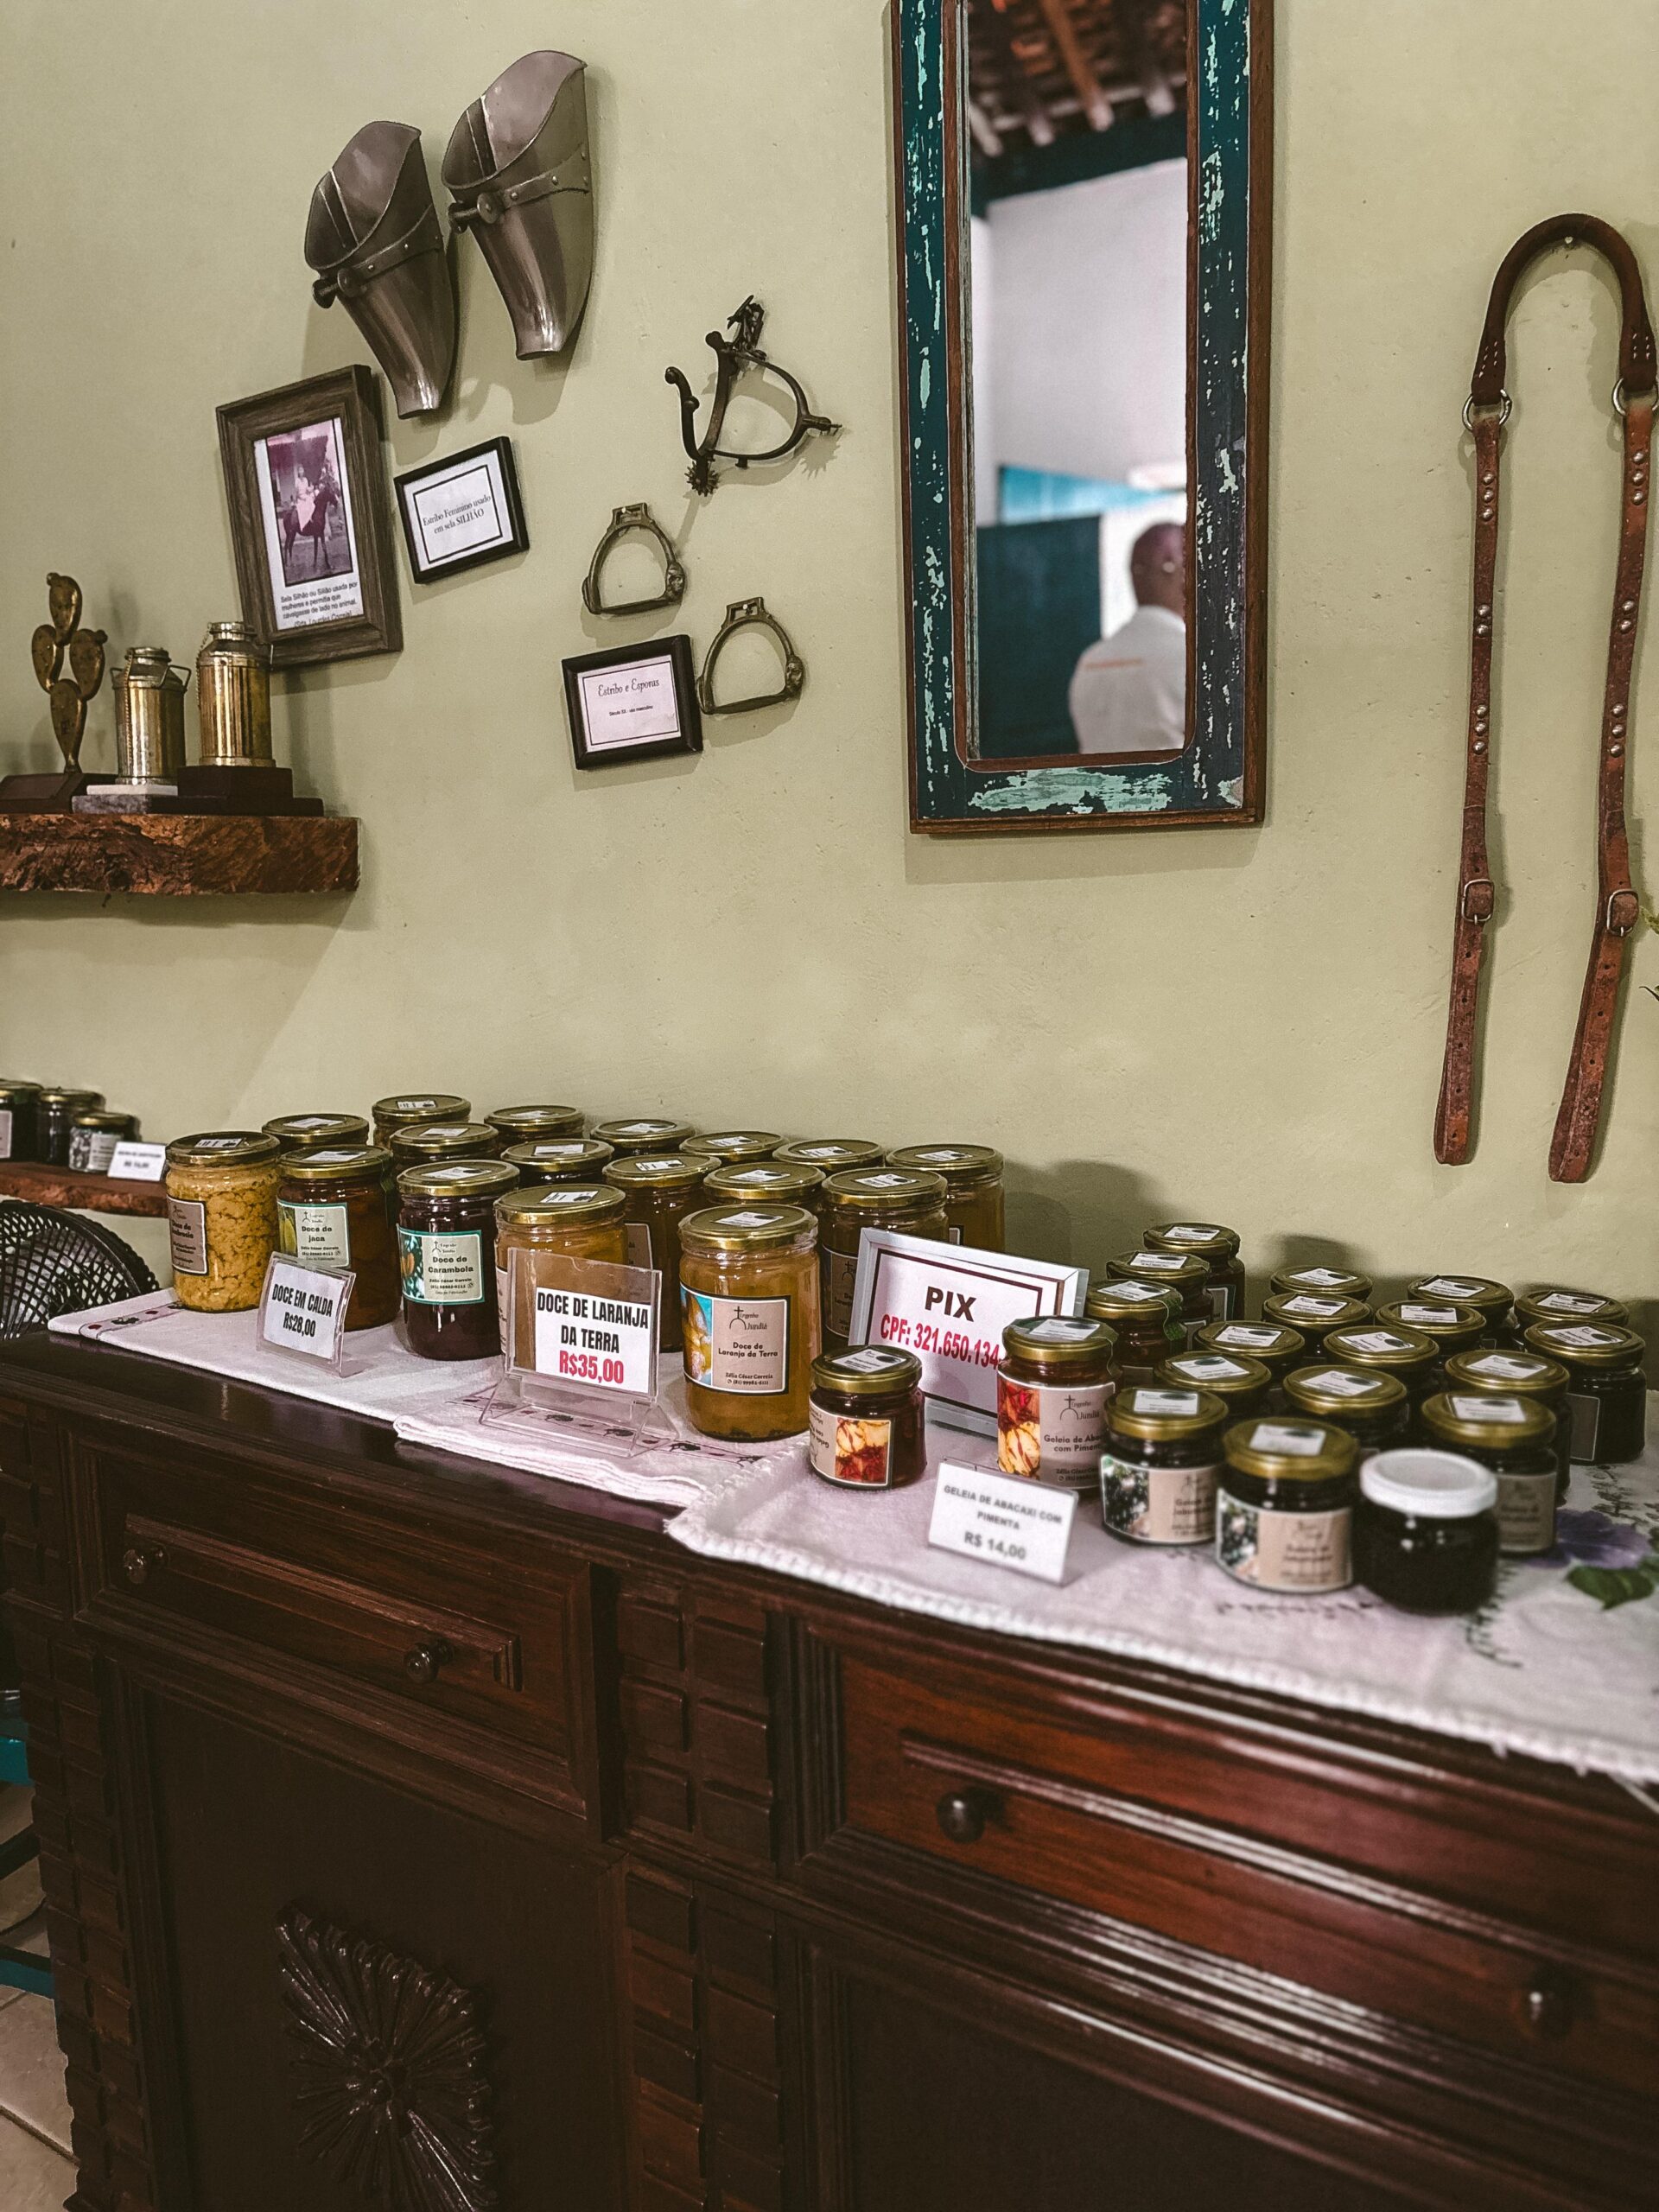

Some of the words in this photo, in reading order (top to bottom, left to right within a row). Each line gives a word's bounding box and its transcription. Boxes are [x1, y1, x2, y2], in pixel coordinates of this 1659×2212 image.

[423, 513, 444, 526] Estribo
[443, 503, 473, 518] Feminino
[473, 494, 491, 507] usado
[434, 525, 444, 534] em
[444, 519, 456, 530] sela
[598, 683, 623, 697] Estribo
[631, 677, 660, 692] Esporas
[308, 1235, 326, 1243] jaca
[271, 1283, 294, 1305] DOCE
[294, 1289, 307, 1310] EM
[307, 1294, 334, 1318] CALDA
[537, 1292, 569, 1315] DOCE
[572, 1297, 588, 1319] DE
[592, 1300, 649, 1329] LARANJA
[925, 1286, 977, 1322] PIX
[283, 1311, 316, 1338] R$28,00
[880, 1313, 911, 1345] CPF:
[561, 1325, 577, 1346] DA
[581, 1327, 620, 1354] TERRA
[718, 1347, 746, 1358] Laranja
[559, 1350, 624, 1384] R$35,00
[1044, 1434, 1071, 1443] Geleia
[944, 1484, 976, 1502] GELEIA
[979, 1494, 991, 1505] DE
[994, 1499, 1037, 1517] ABACAXI
[1039, 1510, 1063, 1524] COM
[976, 1510, 1020, 1530] PIMENTA
[964, 1531, 982, 1548] R$
[987, 1538, 1027, 1560] 14,00
